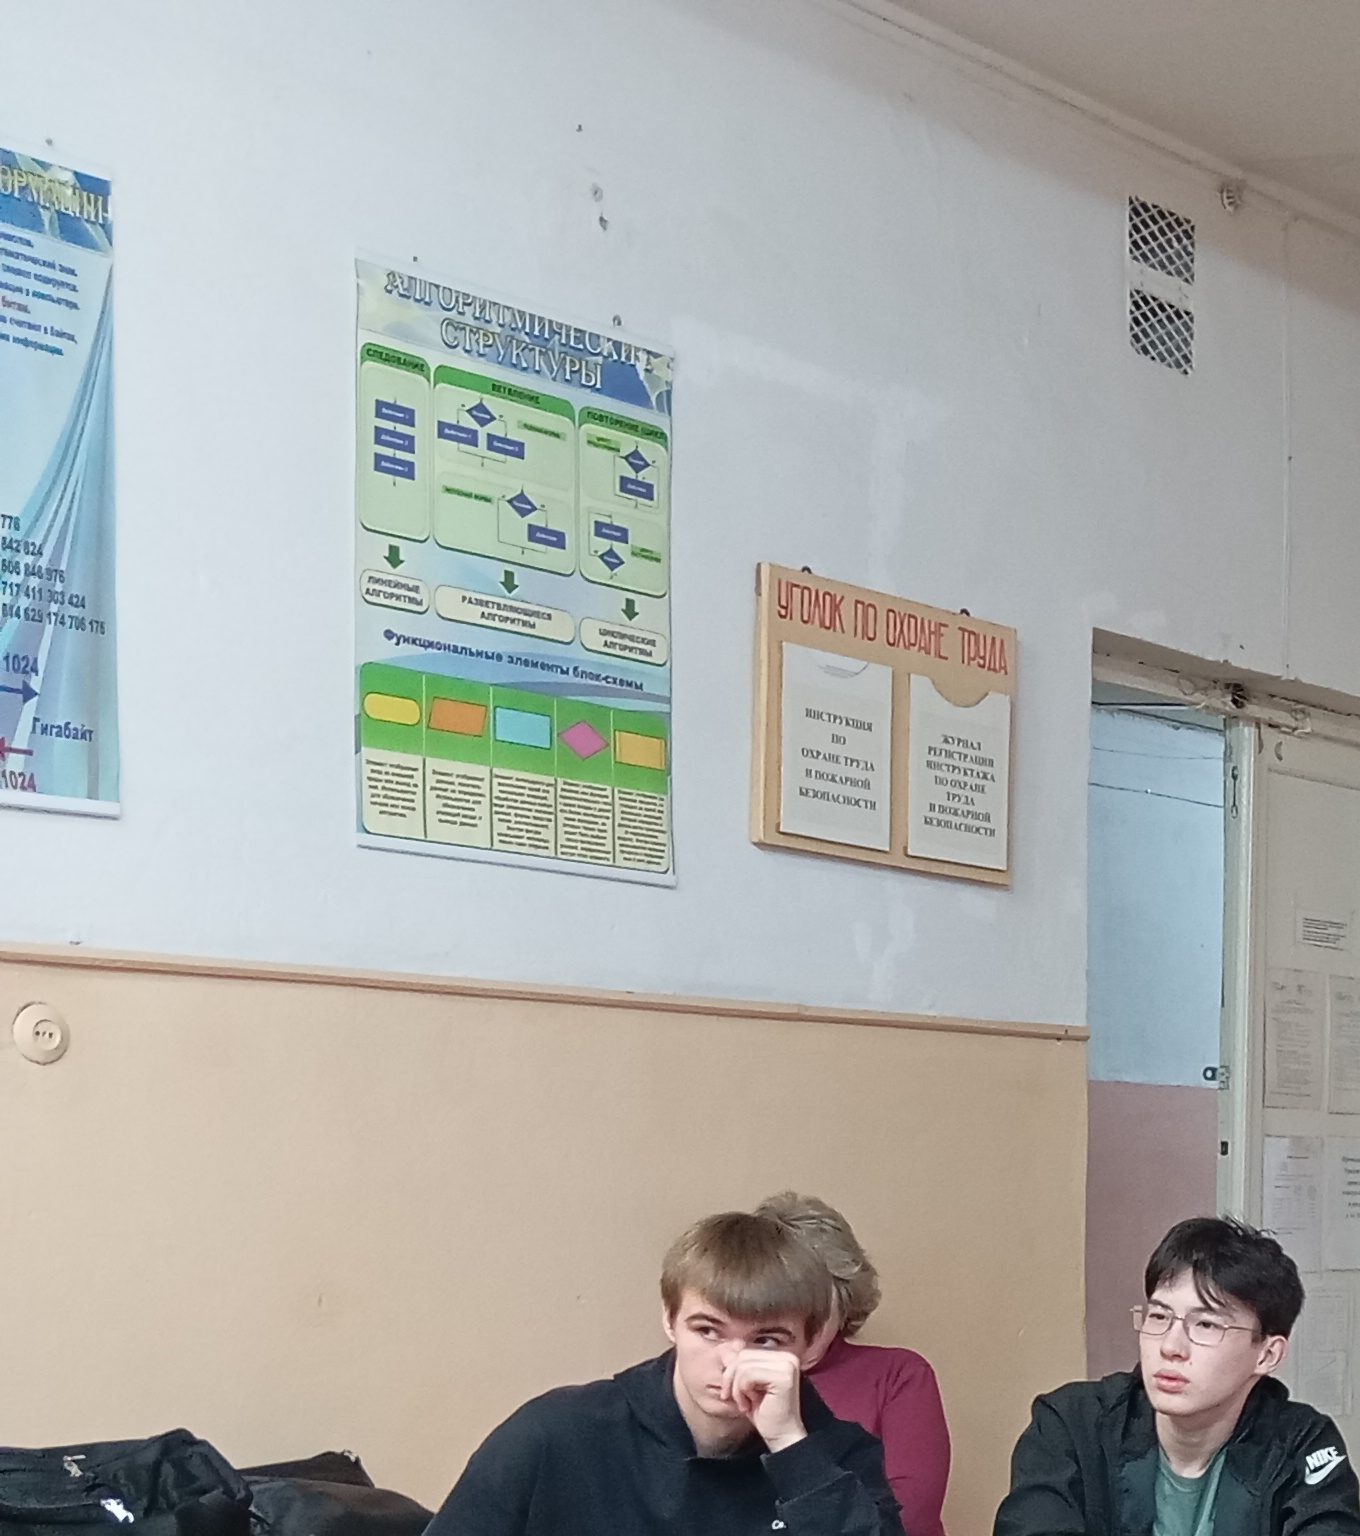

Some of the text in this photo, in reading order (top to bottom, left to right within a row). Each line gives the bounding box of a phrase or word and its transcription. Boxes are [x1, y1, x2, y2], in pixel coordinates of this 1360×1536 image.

[440, 317, 602, 389] СТРУКТУРЫ
[364, 587, 423, 607] АЛГОРИТМЫ
[479, 610, 536, 630] АЛГОРИТМЫ
[777, 577, 1009, 676] УГОЛОК ПО ОХРАНЕ ТРУДА
[382, 628, 644, 692] Функциональные элементы блок-схемы
[602, 639, 653, 658] АЛГОРИТМЫ
[2, 654, 39, 676] 1024
[31, 716, 94, 742] Гигабайт
[804, 706, 873, 733] ИНСТРУКЦИЯ
[830, 733, 847, 746] ПО
[941, 733, 982, 751] ЖУРНАЛ
[801, 746, 876, 772] ОХРАНЕ ТРУДА
[927, 745, 995, 769] РЕГИСТРАЦИИ
[1, 769, 37, 793] 1024
[804, 767, 871, 792] И ПОЖАРНОЙ
[925, 759, 996, 783] ИНСТРУКТАЖА
[933, 774, 987, 795] ПО ОХРАНЕ
[798, 785, 877, 811] БЕЗОПАСНОСТИ
[946, 791, 976, 807] ТРУДА
[936, 804, 991, 824] ПОЖАРНОЙ
[923, 815, 996, 838] БЕЗОПАСНОСТИ
[1305, 1445, 1339, 1471] NIKE
